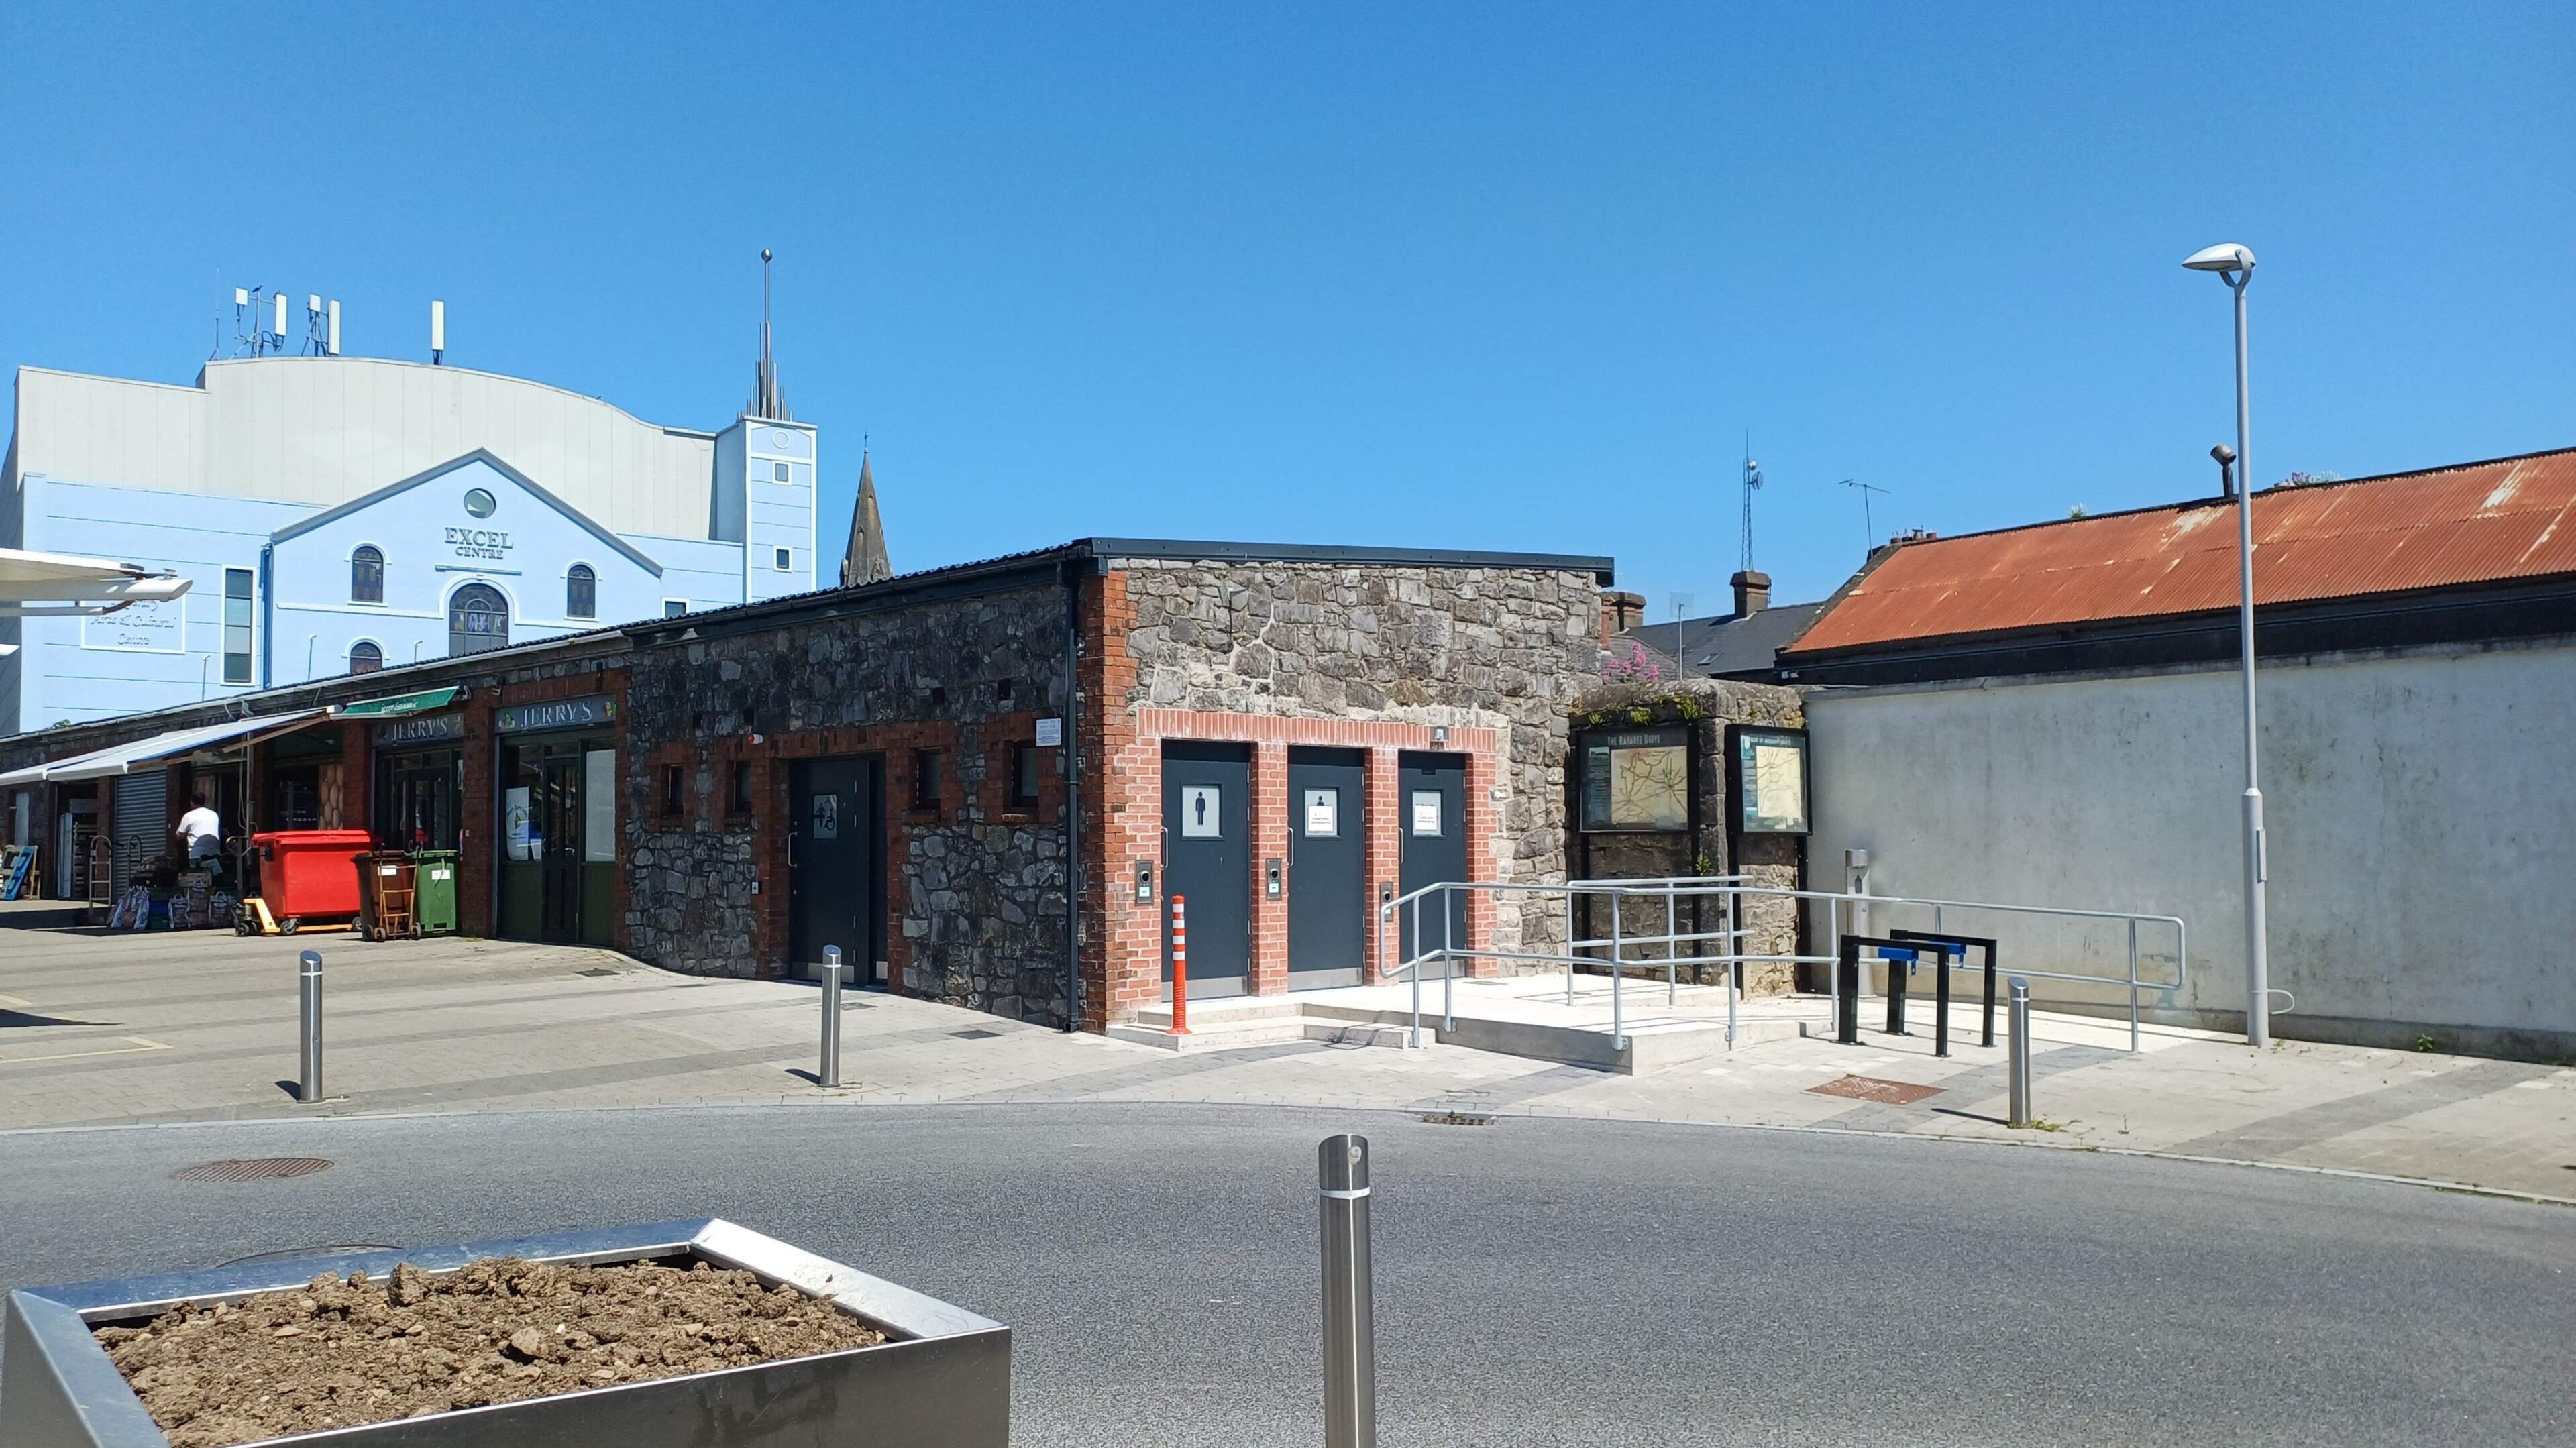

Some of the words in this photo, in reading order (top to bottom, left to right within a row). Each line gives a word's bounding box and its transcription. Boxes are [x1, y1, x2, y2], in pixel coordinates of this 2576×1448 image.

[445, 526, 514, 549] EXCEL
[455, 546, 504, 560] CENTRE
[520, 700, 593, 729] JERRY'S
[391, 717, 448, 744] JERRY'S
